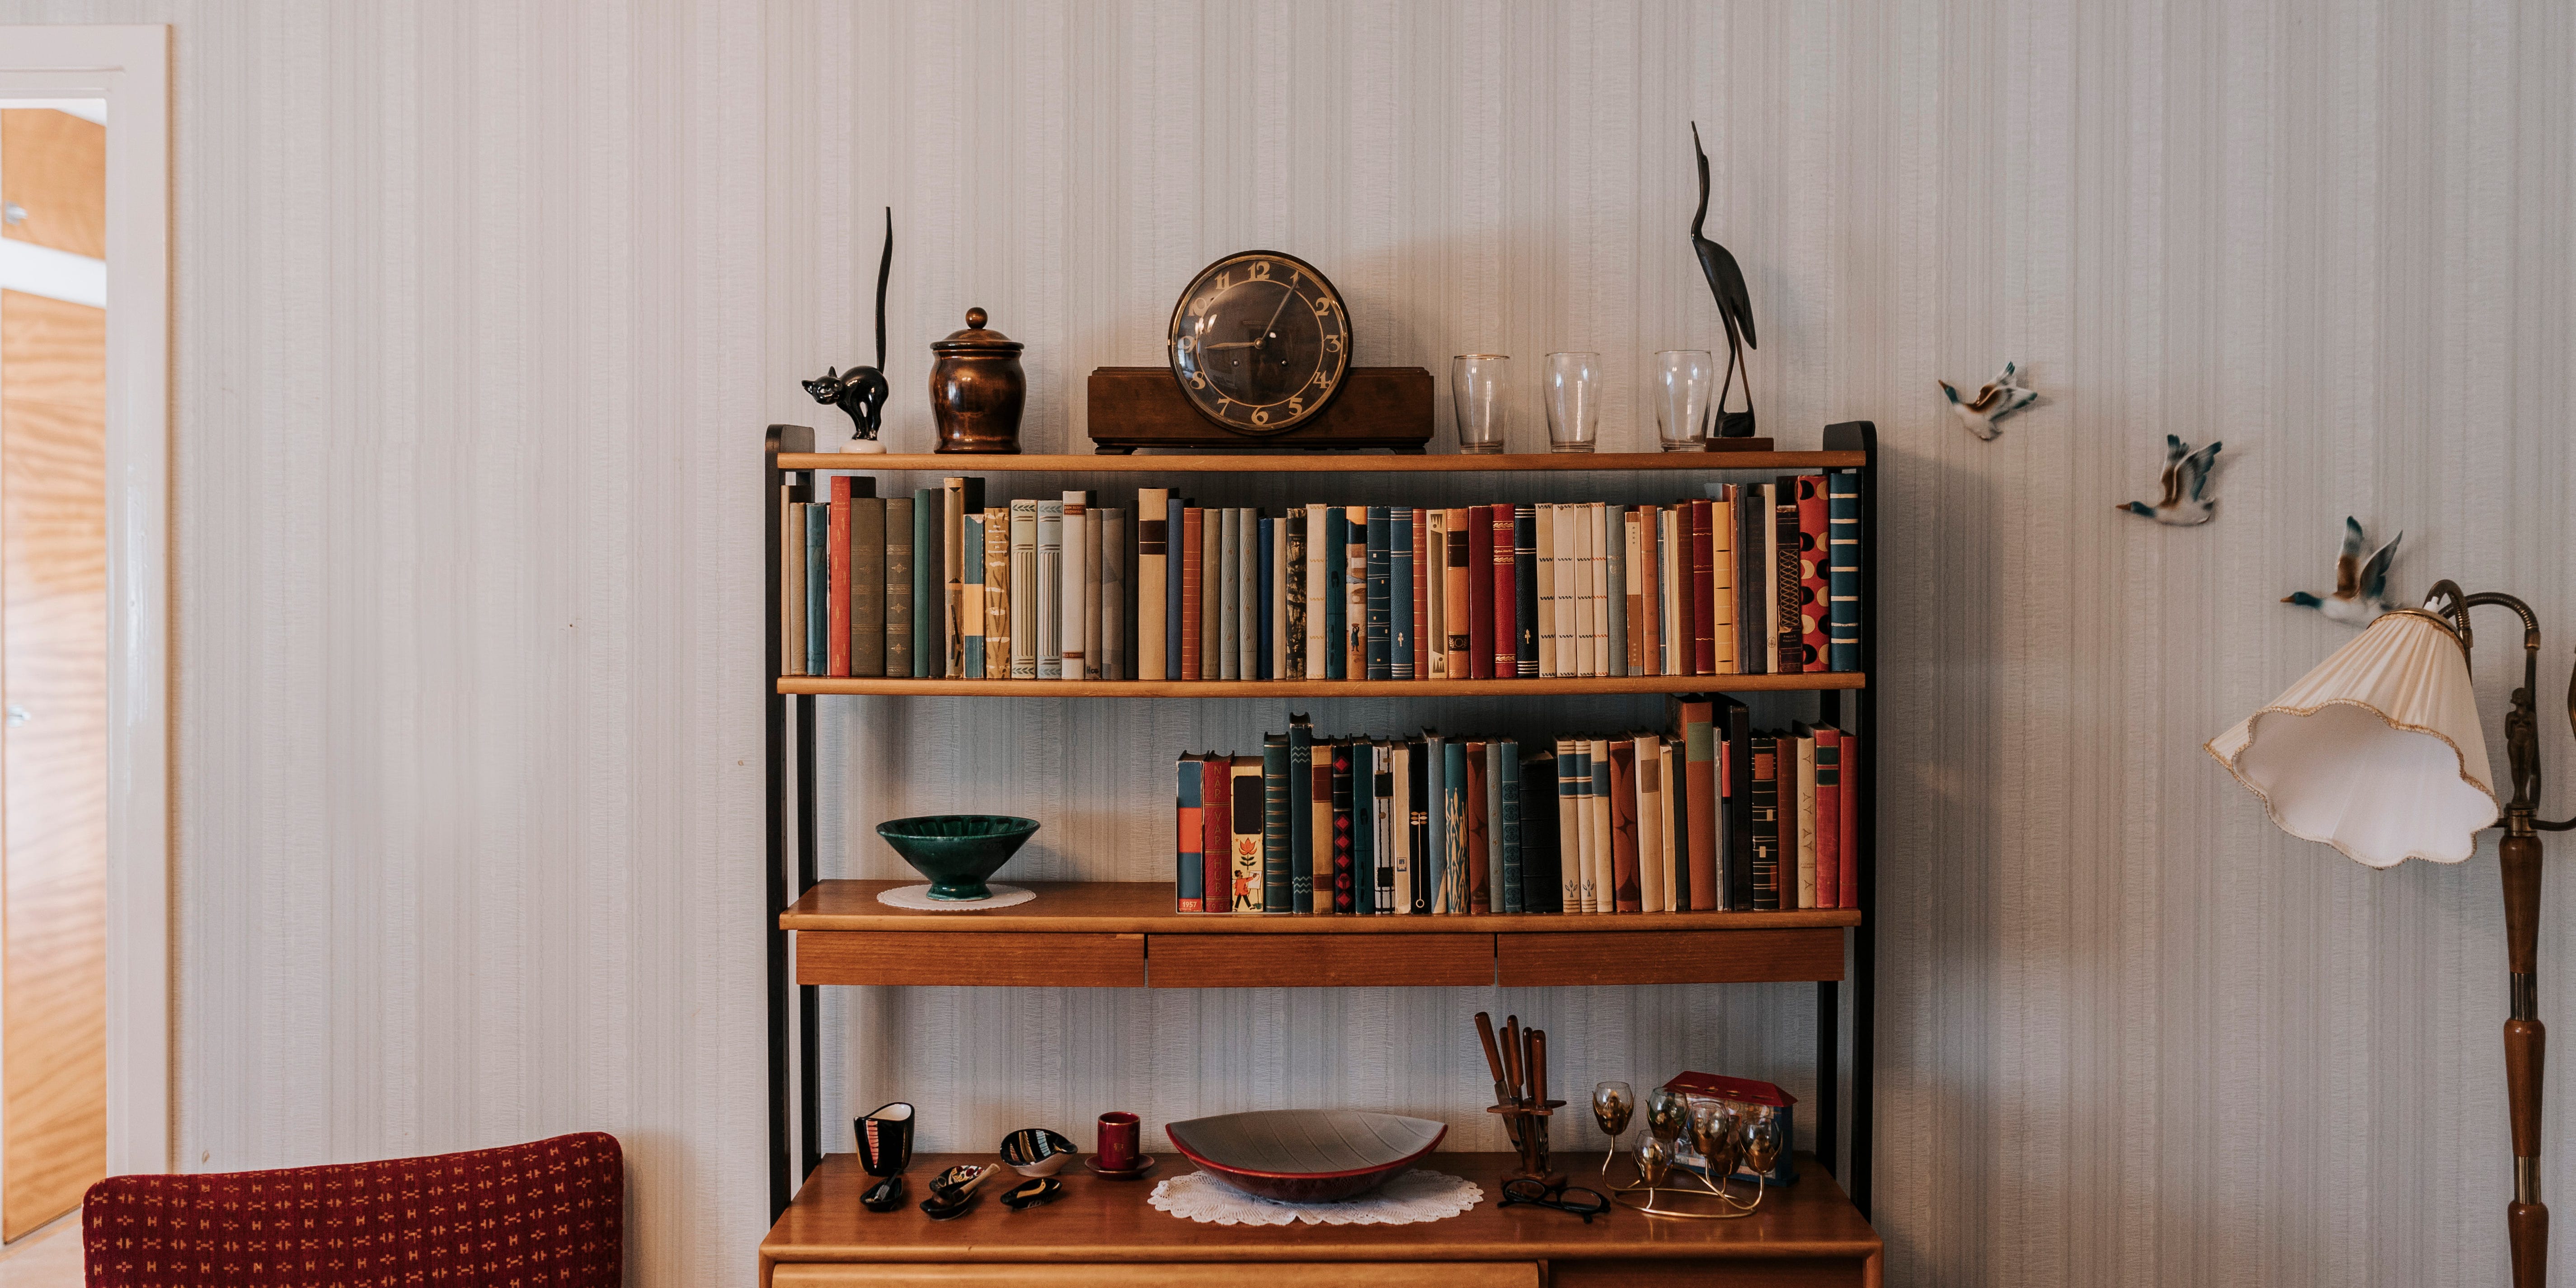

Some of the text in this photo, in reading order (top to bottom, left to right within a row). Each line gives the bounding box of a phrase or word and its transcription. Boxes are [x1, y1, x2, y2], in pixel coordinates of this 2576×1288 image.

[1215, 271, 1229, 289] 11
[1248, 261, 1270, 281] 12
[1290, 270, 1300, 288] 1
[1188, 297, 1207, 316] 10
[1316, 297, 1330, 316] 2
[1180, 336, 1196, 353] 9
[1324, 335, 1341, 352] 3
[1190, 371, 1205, 390] 8
[1313, 370, 1331, 389] 4
[1217, 398, 1232, 416] 7
[1251, 406, 1269, 425] 6
[1289, 397, 1303, 416] 5
[1214, 859, 1222, 893] HUR
